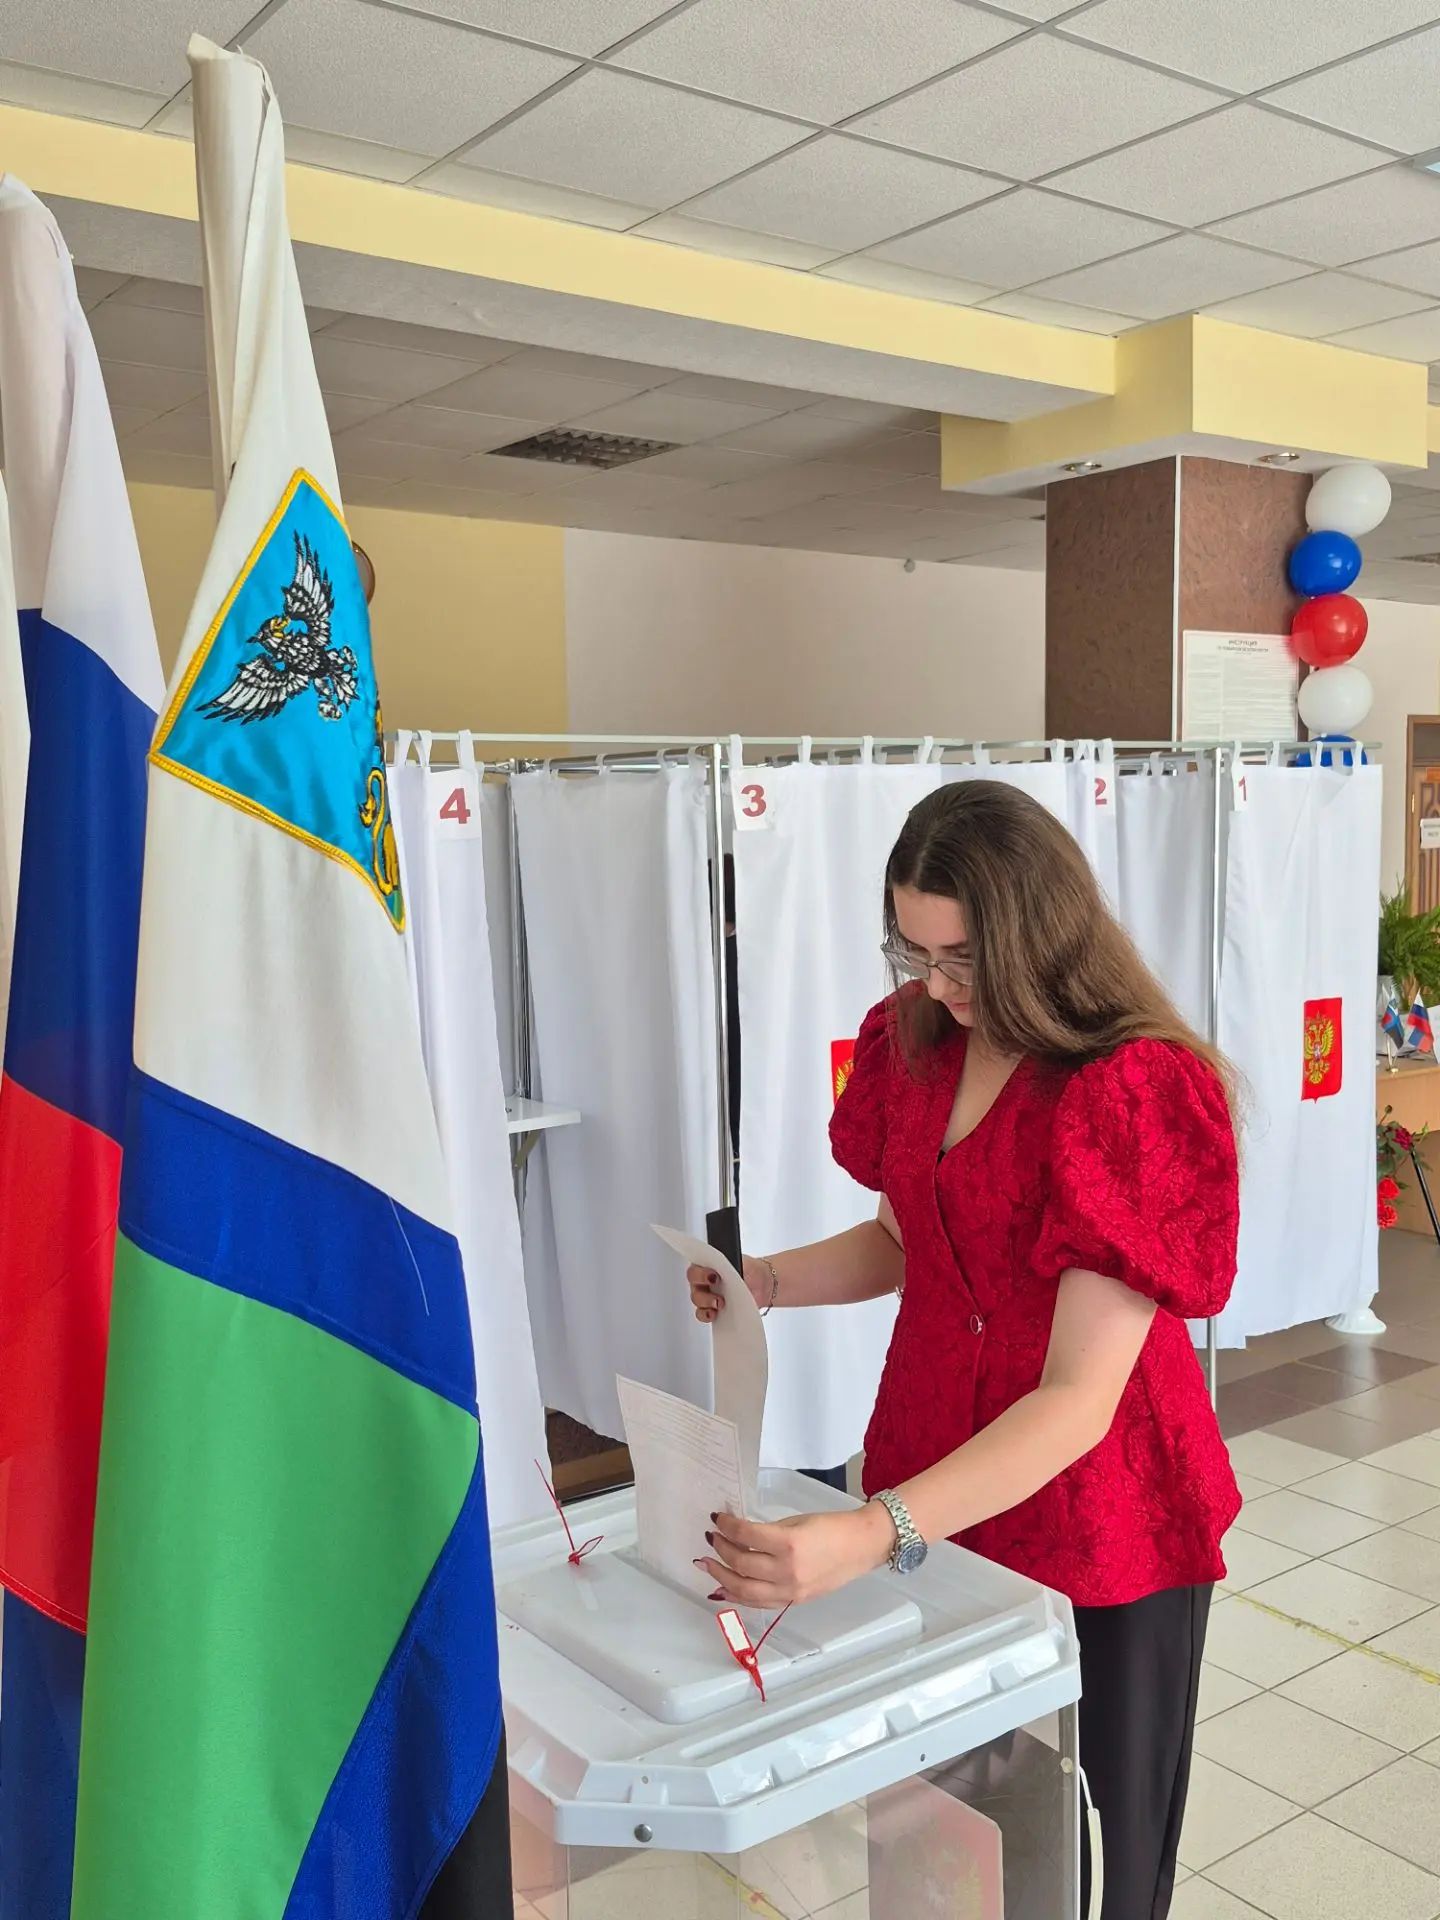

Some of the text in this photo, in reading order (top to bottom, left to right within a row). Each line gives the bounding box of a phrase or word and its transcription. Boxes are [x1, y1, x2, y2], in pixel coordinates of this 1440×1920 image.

[740, 784, 767, 818] 3
[1094, 777, 1108, 806] 2
[1238, 775, 1248, 802] 1
[439, 787, 471, 825] 4
